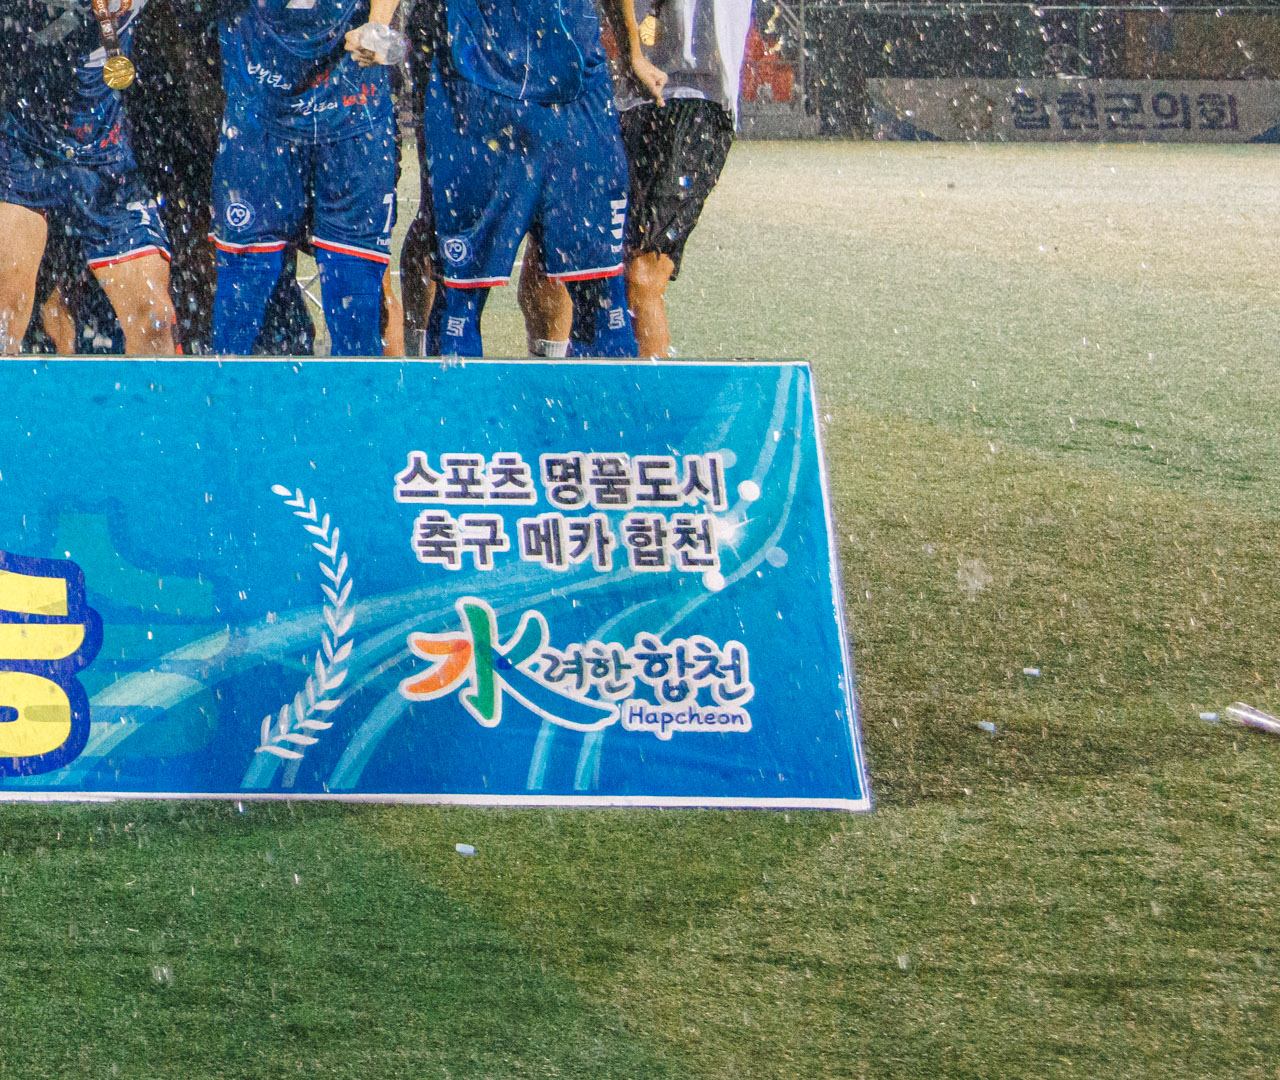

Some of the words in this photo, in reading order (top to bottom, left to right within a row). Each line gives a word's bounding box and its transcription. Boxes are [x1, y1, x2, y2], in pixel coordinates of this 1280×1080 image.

[400, 456, 531, 500] 스포츠
[545, 456, 722, 507] 명품도시
[416, 514, 504, 566] 축구
[523, 517, 610, 566] 메카
[625, 518, 715, 568] 합천
[628, 705, 745, 732] Hapcheon
